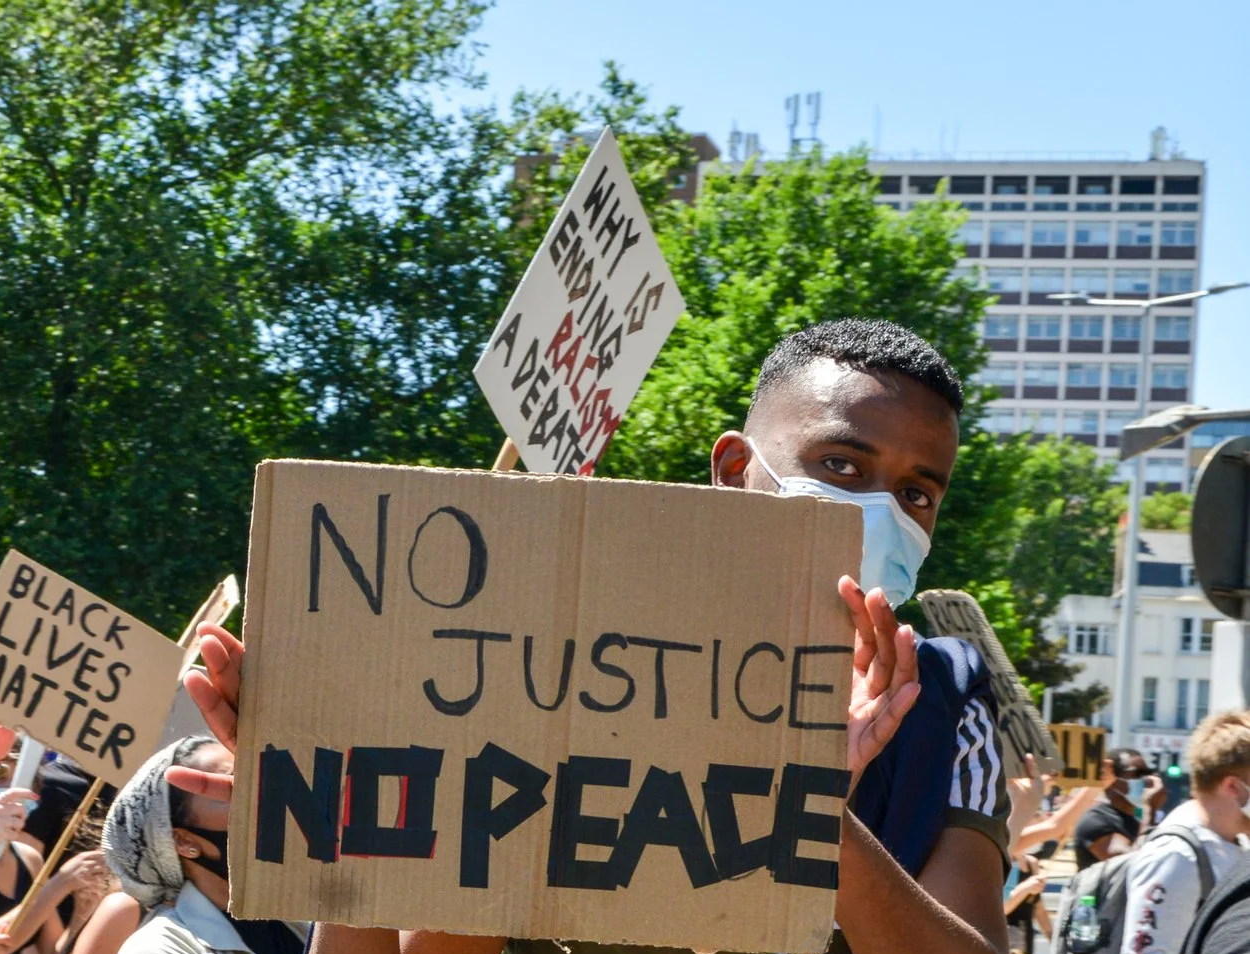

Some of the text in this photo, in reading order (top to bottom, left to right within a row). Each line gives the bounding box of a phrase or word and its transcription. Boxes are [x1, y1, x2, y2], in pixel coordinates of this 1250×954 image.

[549, 210, 623, 382] ENDING
[582, 165, 665, 336] WHY IS
[494, 313, 522, 367] A
[544, 310, 621, 467] RACISM
[8, 563, 131, 650] BLACK
[308, 493, 490, 615] NO
[422, 628, 854, 730] JUSTICE
[255, 741, 852, 891] NO PEACE
[1051, 730, 1104, 780] LM
